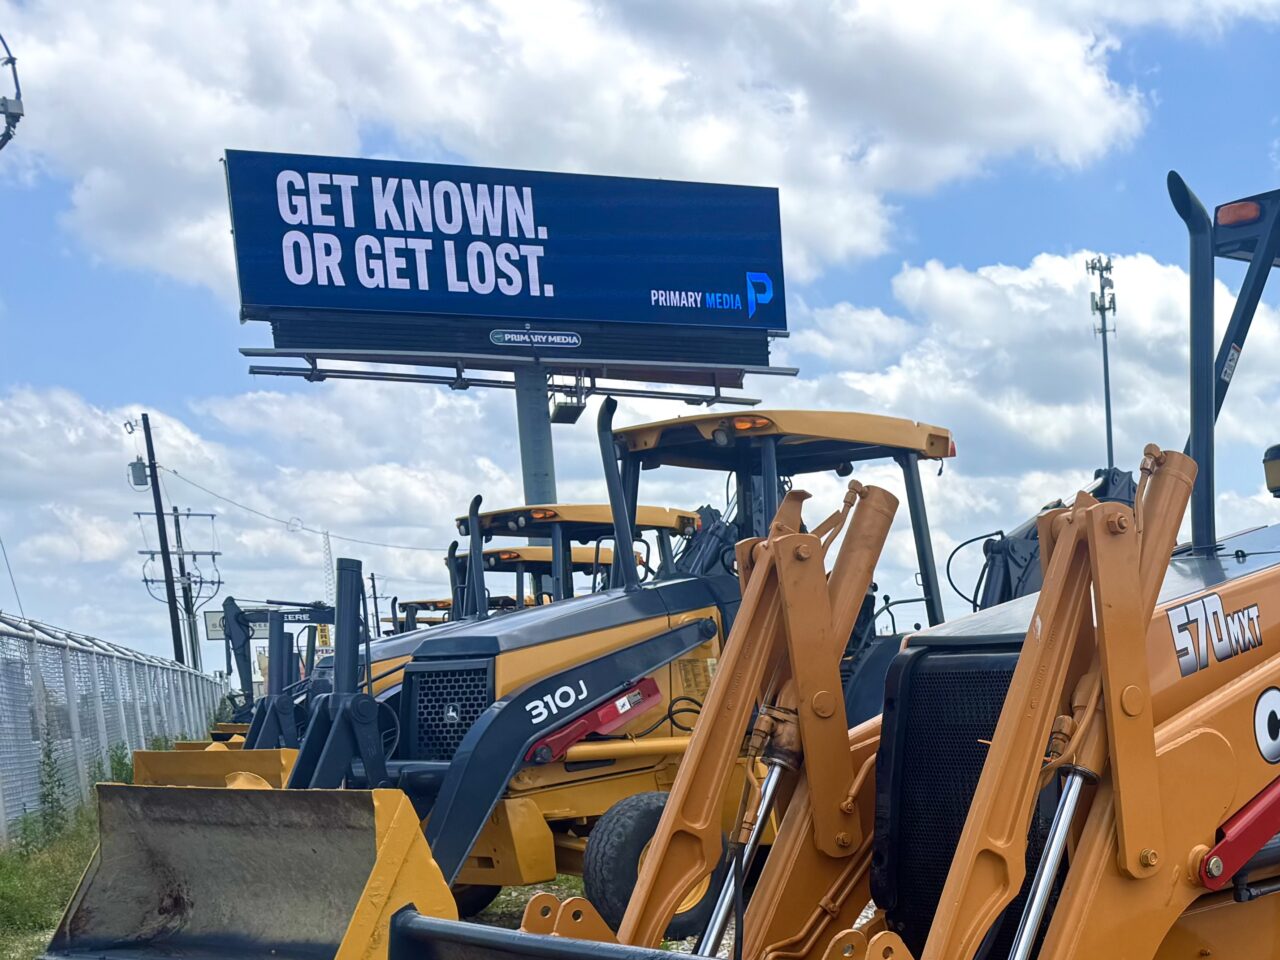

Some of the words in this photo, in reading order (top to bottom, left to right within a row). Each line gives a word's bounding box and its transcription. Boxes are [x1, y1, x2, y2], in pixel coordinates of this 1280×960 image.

[276, 169, 359, 228] GET
[371, 176, 549, 240] KNOWN.
[282, 230, 346, 287] OR
[354, 234, 433, 291] GET
[444, 239, 555, 297] LOST.
[650, 289, 702, 308] PRIMARY
[705, 292, 742, 310] MEDIA
[548, 335, 579, 344] MEDIA
[525, 679, 588, 725] 310J
